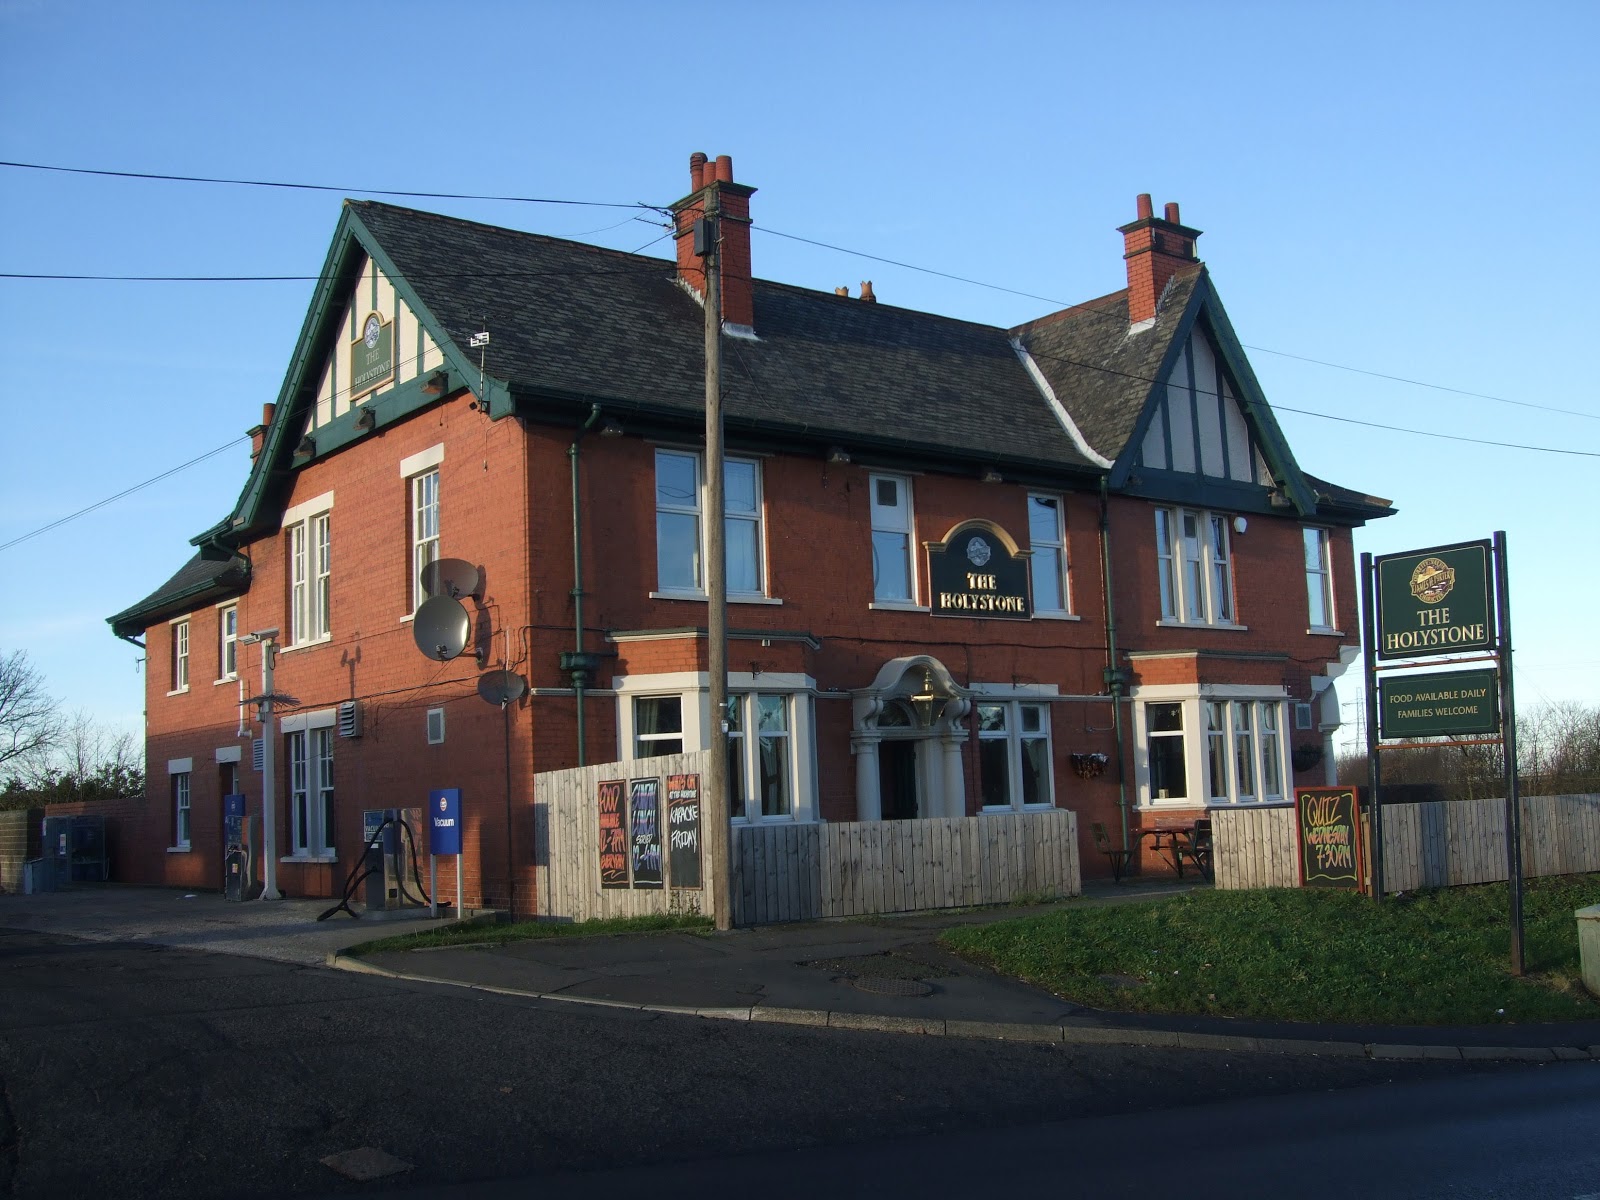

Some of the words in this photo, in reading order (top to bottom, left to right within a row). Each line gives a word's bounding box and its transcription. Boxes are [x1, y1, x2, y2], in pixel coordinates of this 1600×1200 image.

[366, 348, 380, 366] THE
[967, 572, 997, 590] THE
[940, 592, 1025, 612] HOLYSTONE
[1417, 607, 1450, 627] THE
[1387, 623, 1485, 650] HOLYSTONE
[1390, 694, 1413, 704] FOOD
[1415, 690, 1459, 702] AVAILABLE
[1461, 688, 1487, 699] DAILY
[1397, 708, 1433, 719] FAMILIES
[1435, 705, 1479, 717] WELCOME
[669, 805, 699, 825] KARAOKE
[1307, 796, 1342, 827] QUIZ
[434, 817, 455, 827] Vacuum
[632, 809, 656, 837] LUNCH
[670, 828, 697, 854] FRIDAY
